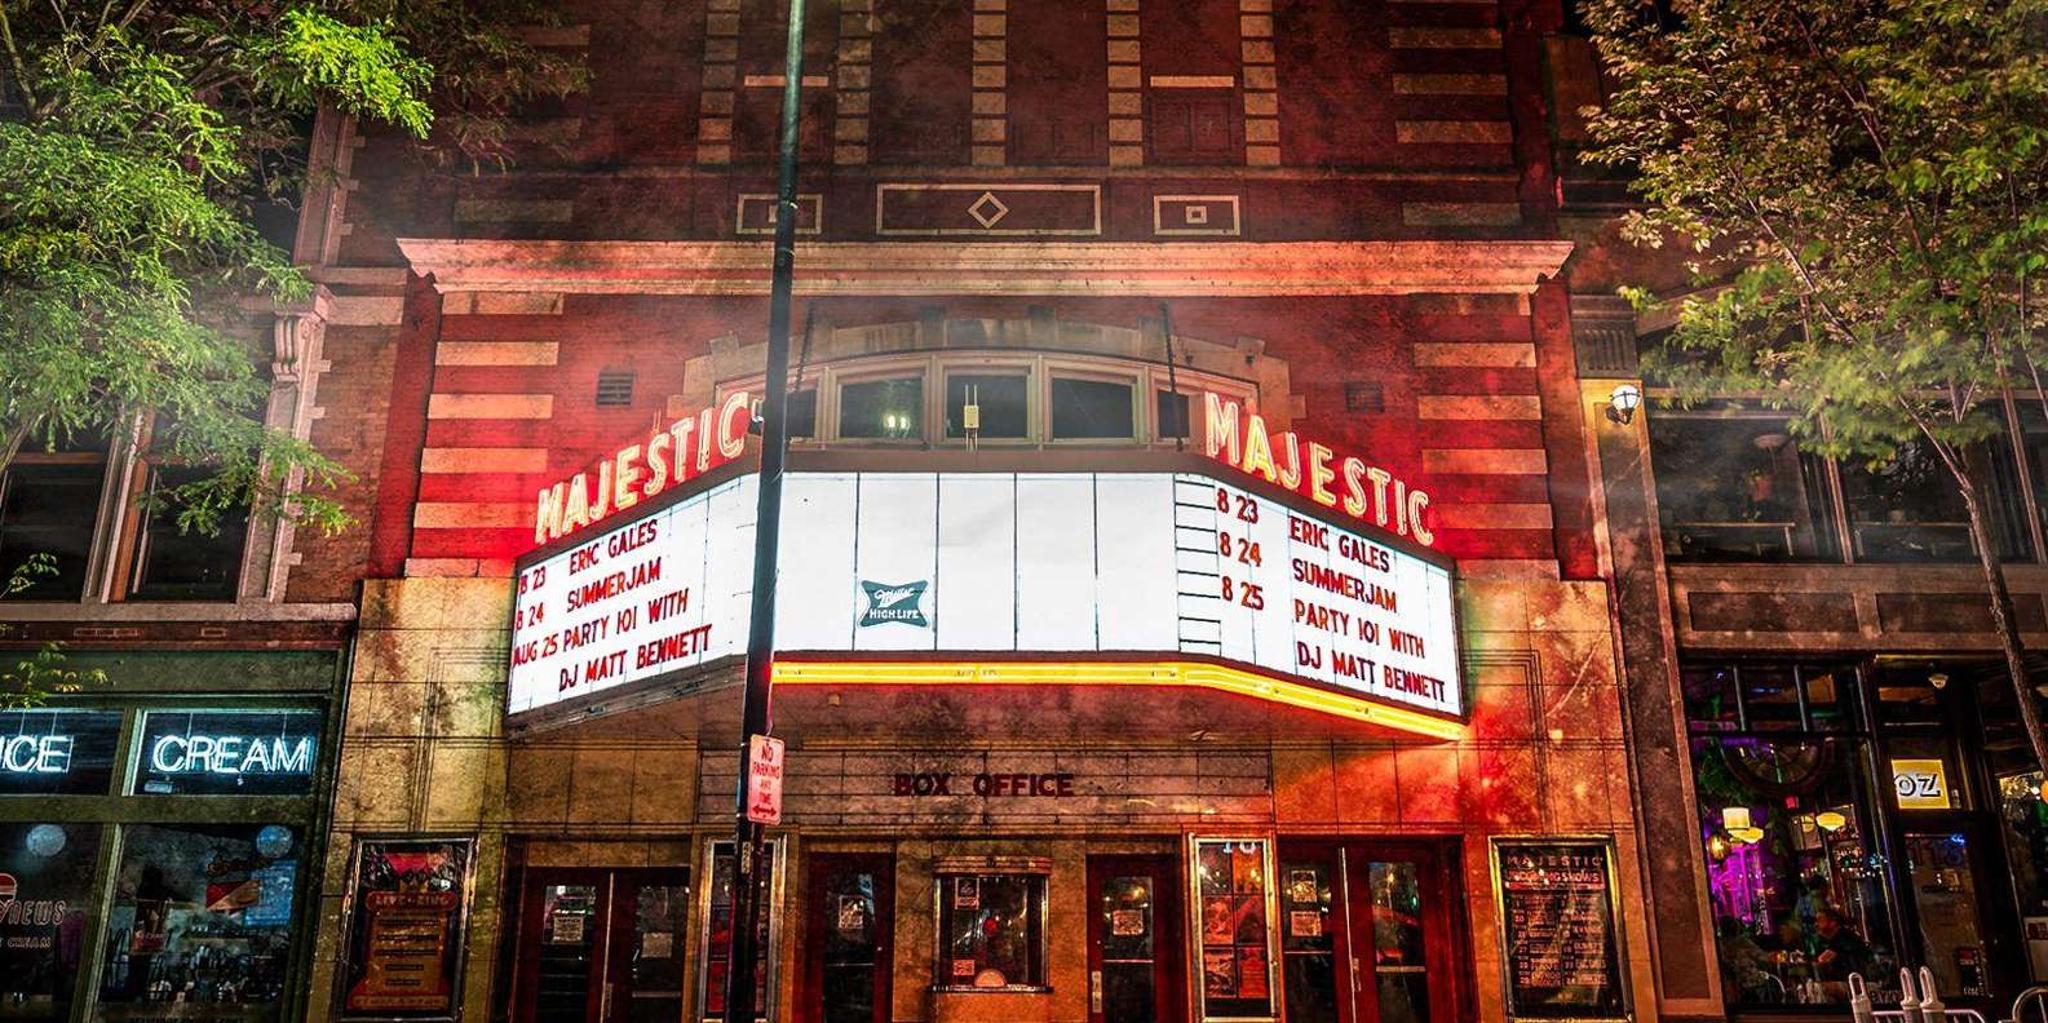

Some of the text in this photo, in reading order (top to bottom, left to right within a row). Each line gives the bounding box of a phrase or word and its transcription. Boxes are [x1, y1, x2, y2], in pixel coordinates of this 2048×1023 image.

[534, 391, 749, 545] MAJESTIC
[1204, 390, 1434, 547] MAJESTIC
[1217, 488, 1259, 524] 8 23
[569, 519, 658, 576] ERIC GALES
[1220, 532, 1262, 568] 8 24
[1289, 515, 1390, 574] ERIC GALES
[533, 565, 547, 590] 23
[567, 556, 662, 613] SUMMERJAM
[1222, 576, 1265, 611] 8 25
[1292, 558, 1398, 614] SUMMERJAM
[511, 641, 538, 668] AUG
[541, 633, 559, 658] 25
[563, 616, 609, 652] PARTY
[649, 588, 690, 624] WITH
[528, 602, 544, 627] 24
[869, 609, 919, 619] HIGH LIFE
[1294, 599, 1350, 637] PARTY
[1388, 627, 1426, 659] WITH
[559, 624, 713, 693] DJ MATT BENNETT
[1297, 641, 1446, 703] DJ MATT BENNETT
[0, 735, 70, 772] ICE
[153, 735, 309, 773] CREAM
[761, 741, 774, 763] NO
[894, 773, 1075, 796] BOX OFFICE
[1507, 855, 1604, 867] MAJESTIC
